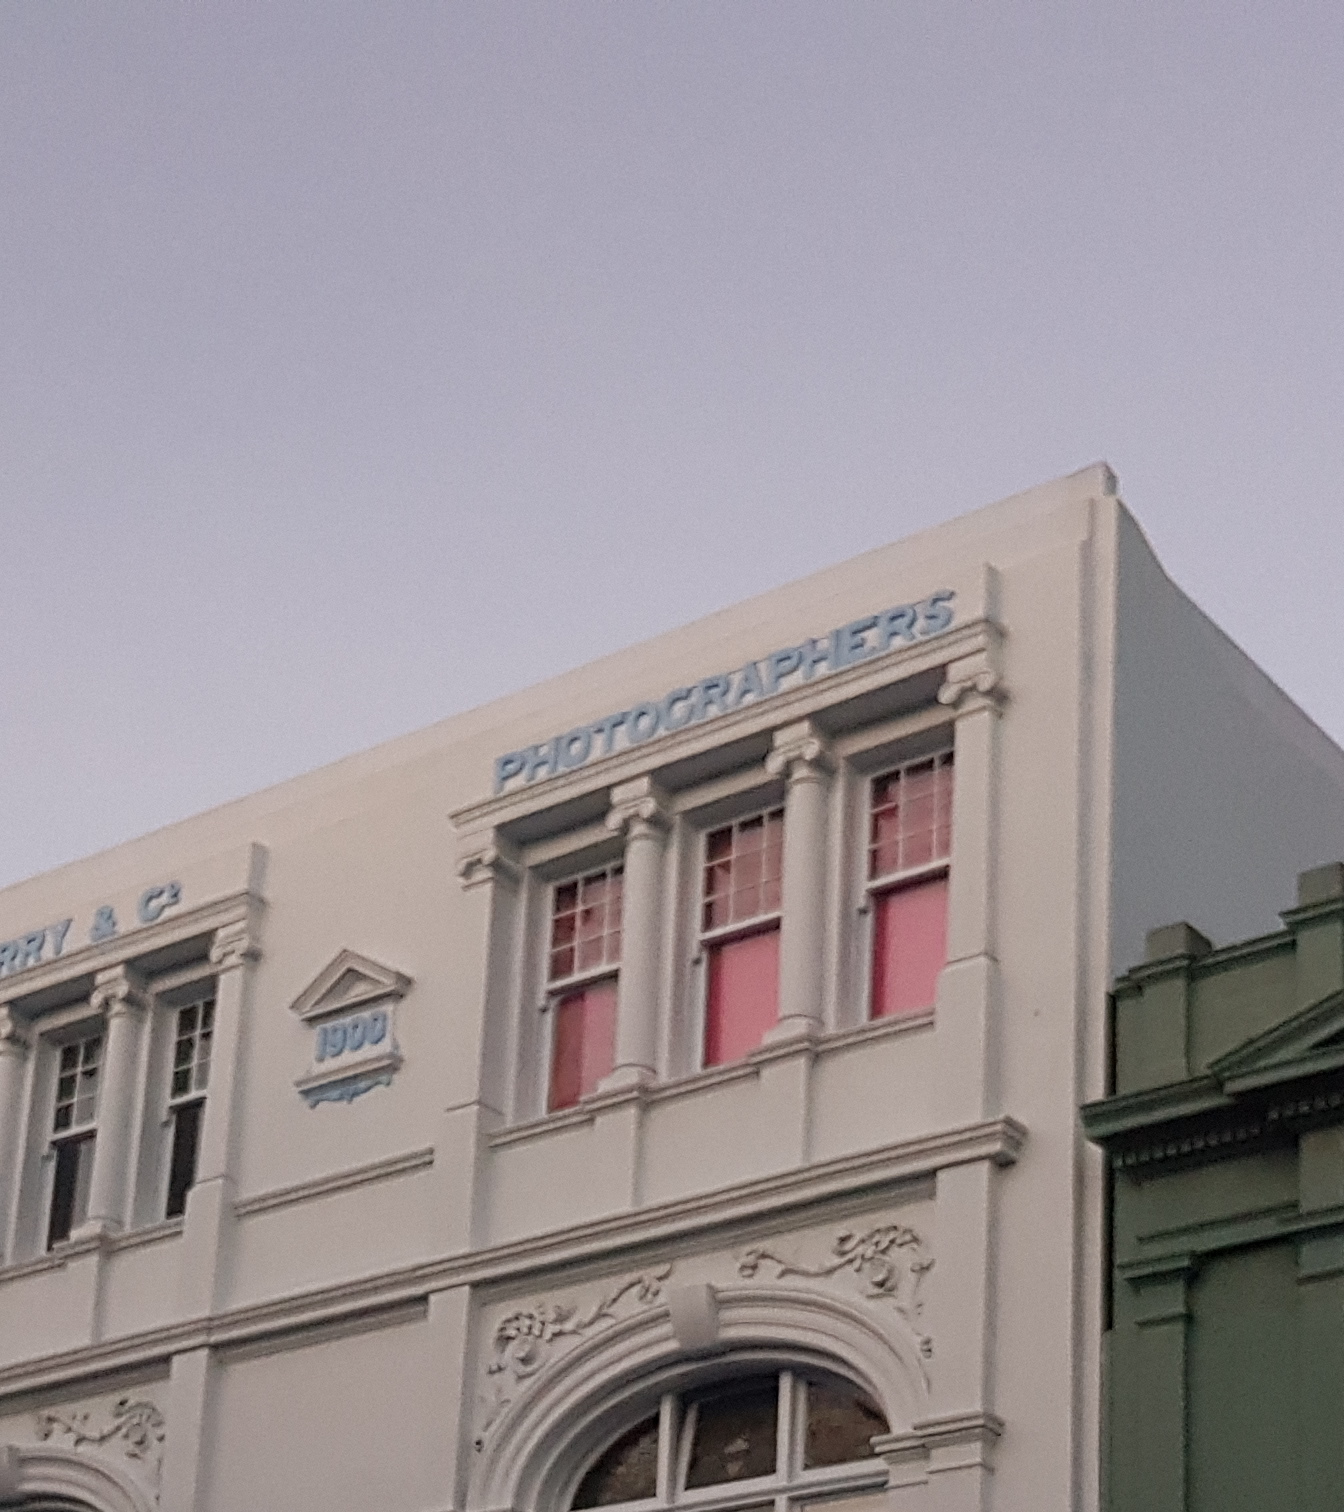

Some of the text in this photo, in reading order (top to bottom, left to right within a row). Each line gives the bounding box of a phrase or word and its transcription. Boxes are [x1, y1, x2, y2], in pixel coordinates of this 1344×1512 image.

[494, 589, 956, 795] PHOTOGRAPHERS
[90, 905, 118, 942] &
[315, 1011, 388, 1062] 1900
